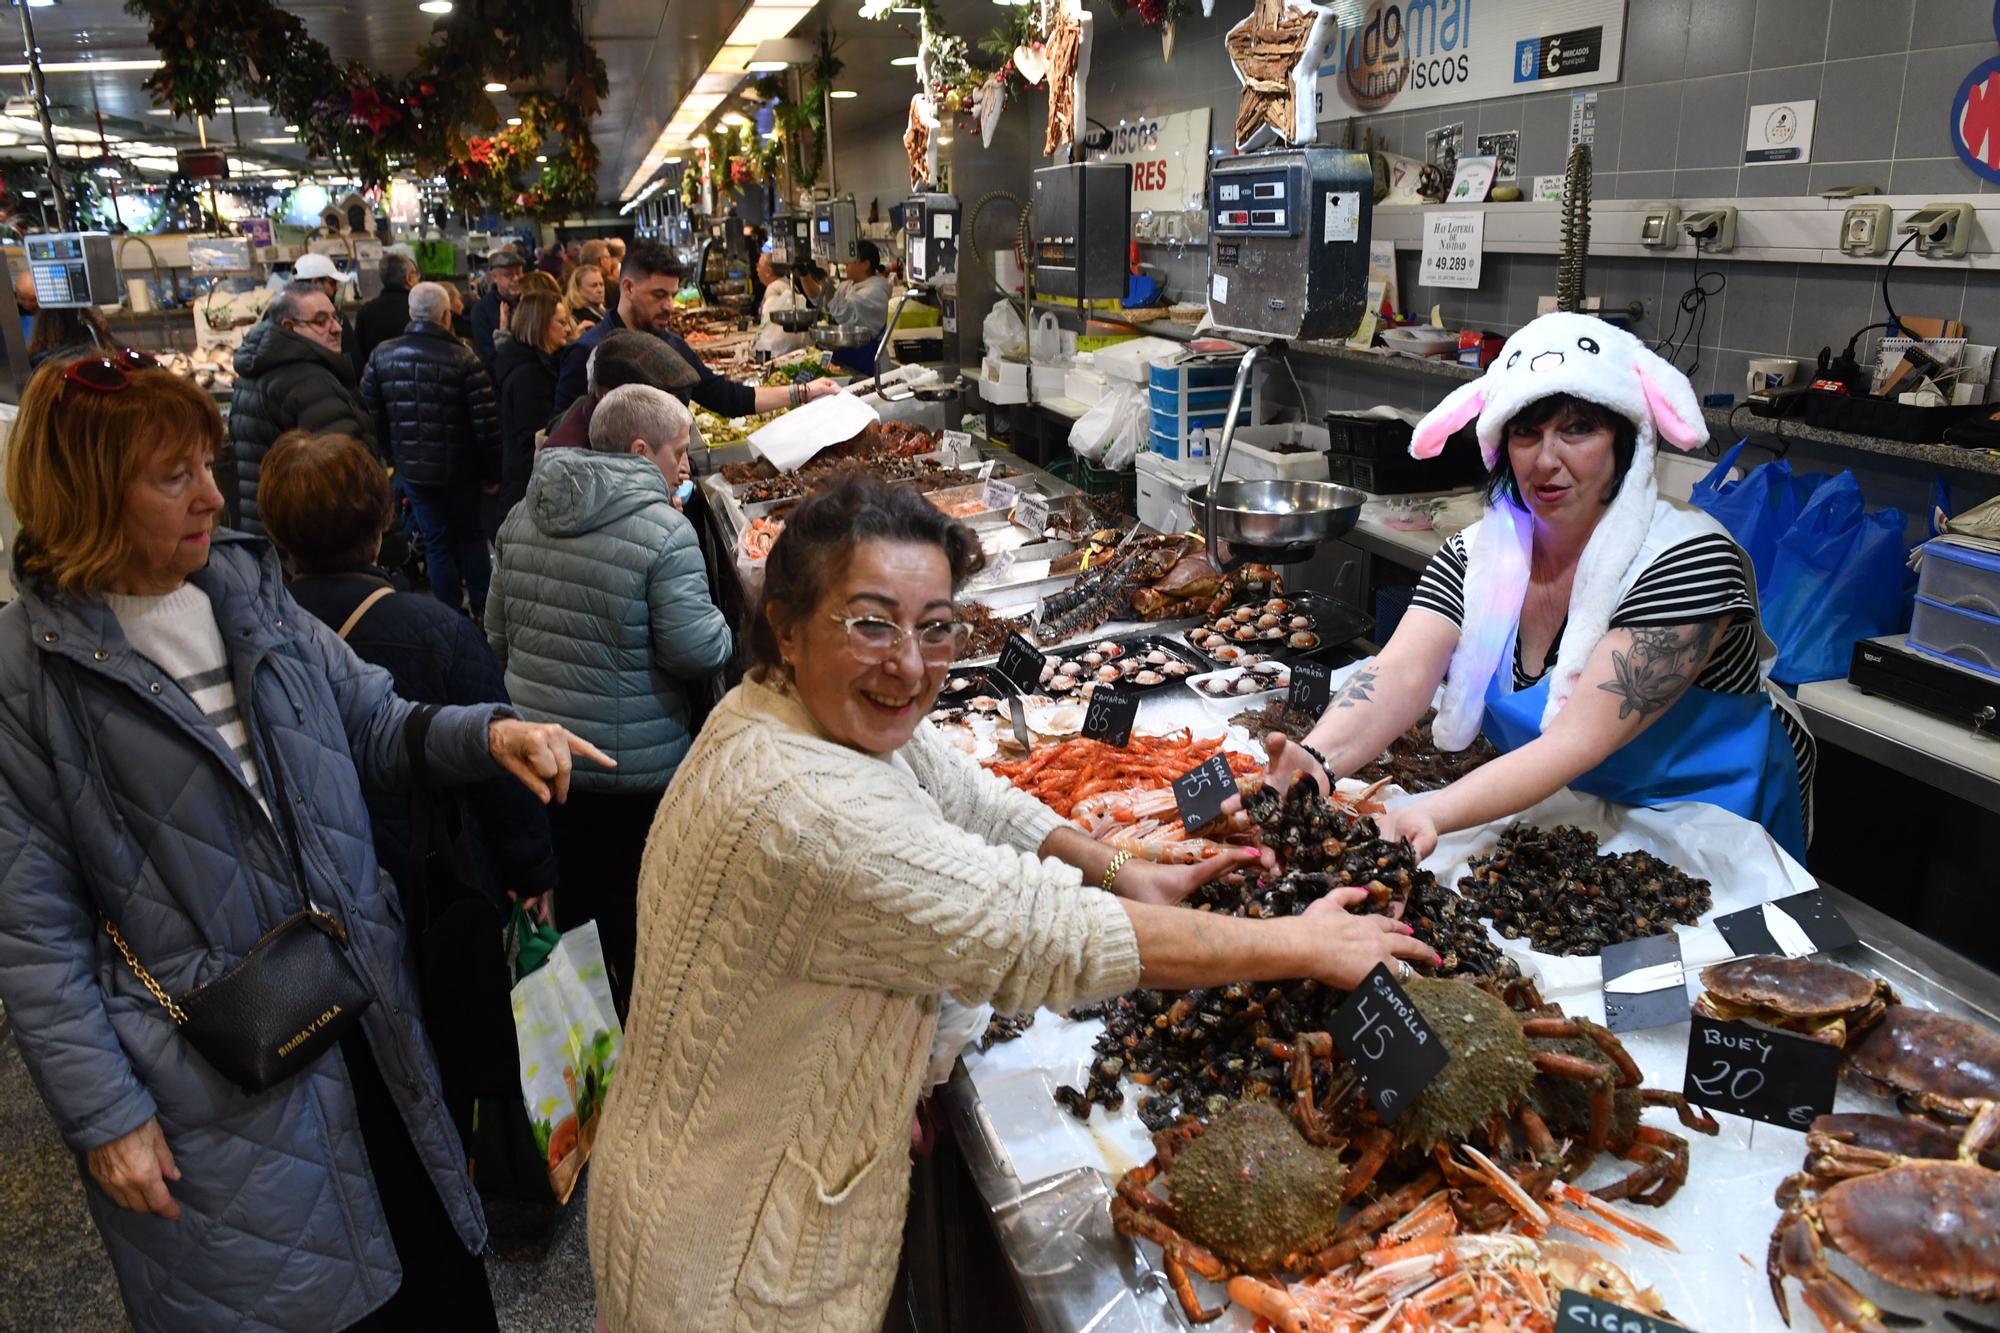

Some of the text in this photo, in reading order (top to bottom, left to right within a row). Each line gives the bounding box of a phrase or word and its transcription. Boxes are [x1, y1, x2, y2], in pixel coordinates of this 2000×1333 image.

[1367, 54, 1469, 97] mariscos
[1086, 122, 1159, 158] MISCOS
[1132, 159, 1167, 192] RES
[1434, 222, 1474, 234] HAY LOTERÍA
[1440, 240, 1467, 251] NAVIDAD
[1435, 257, 1467, 271] 49.289
[1003, 648, 1022, 676] 14
[1293, 680, 1310, 702] 70
[1088, 704, 1111, 732] 85
[1182, 767, 1212, 798] 75
[1374, 975, 1428, 1045] CENTOLLA
[278, 1005, 342, 1057] BIMBA Y LOLA
[1352, 996, 1394, 1060] 45
[1703, 1029, 1773, 1063] BUEY
[1691, 1061, 1765, 1099] 20
[1380, 1088, 1398, 1108] €
[1788, 1105, 1814, 1124] €
